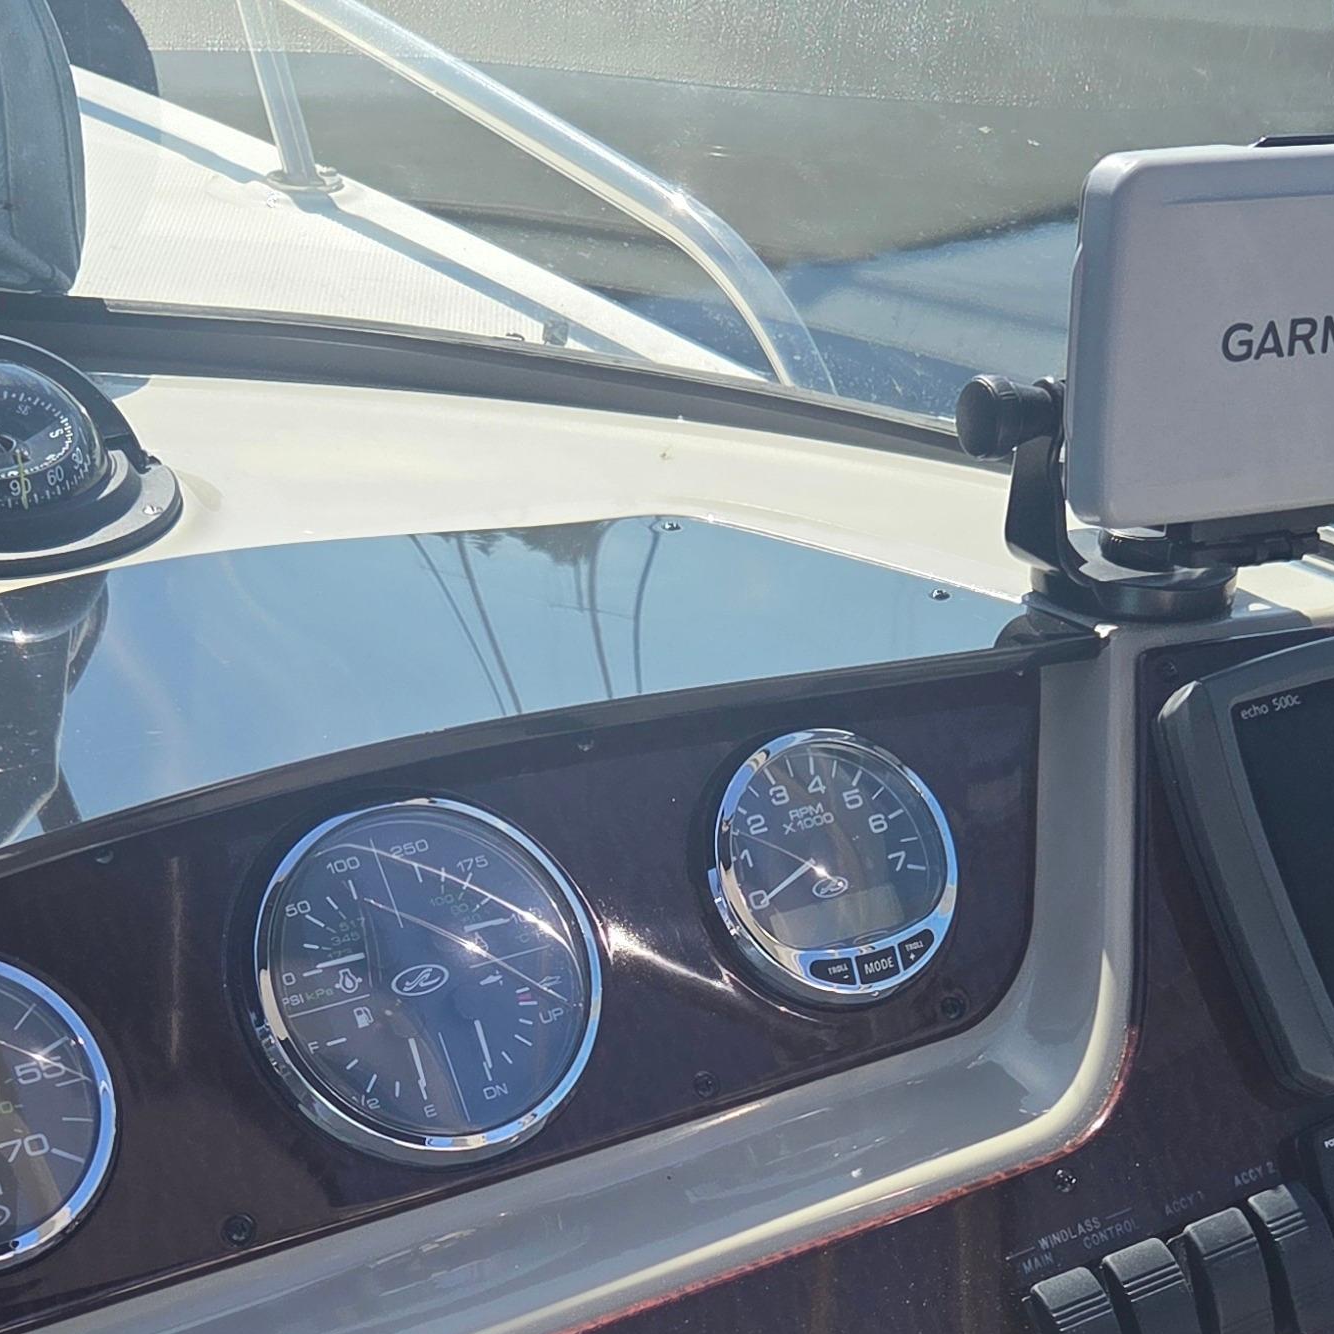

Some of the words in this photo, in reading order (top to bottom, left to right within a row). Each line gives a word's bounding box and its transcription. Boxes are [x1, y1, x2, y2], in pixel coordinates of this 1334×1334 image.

[9, 478, 31, 496] 90
[47, 466, 64, 486] 60
[1240, 704, 1269, 719] echo
[1272, 694, 1301, 711] 500c
[807, 775, 826, 794] 4
[769, 785, 790, 806] 3
[842, 789, 863, 809] 5
[788, 802, 824, 821] RPM
[747, 814, 768, 835] 2
[868, 814, 888, 833] 6
[389, 839, 429, 858] 250
[740, 849, 754, 867] 1
[326, 856, 361, 875] 100
[456, 855, 489, 874] 175
[888, 852, 906, 871] 7
[285, 900, 311, 918] 50
[749, 890, 770, 910] 0
[828, 963, 849, 975] TROLL
[864, 957, 895, 974] MODE
[283, 972, 296, 986] 0
[282, 993, 304, 1006] PSI
[305, 987, 334, 1001] kPa
[539, 1008, 565, 1024] UP
[307, 1042, 320, 1055] F
[15, 1056, 66, 1086] 55
[483, 1083, 509, 1099] DN
[423, 1105, 437, 1118] E
[1234, 1166, 1262, 1186] ACCY
[1266, 1161, 1275, 1173] 2
[1038, 1217, 1100, 1249] WINDLASS
[1022, 1252, 1053, 1273] MAIN
[1083, 1219, 1138, 1249] CONTROL
